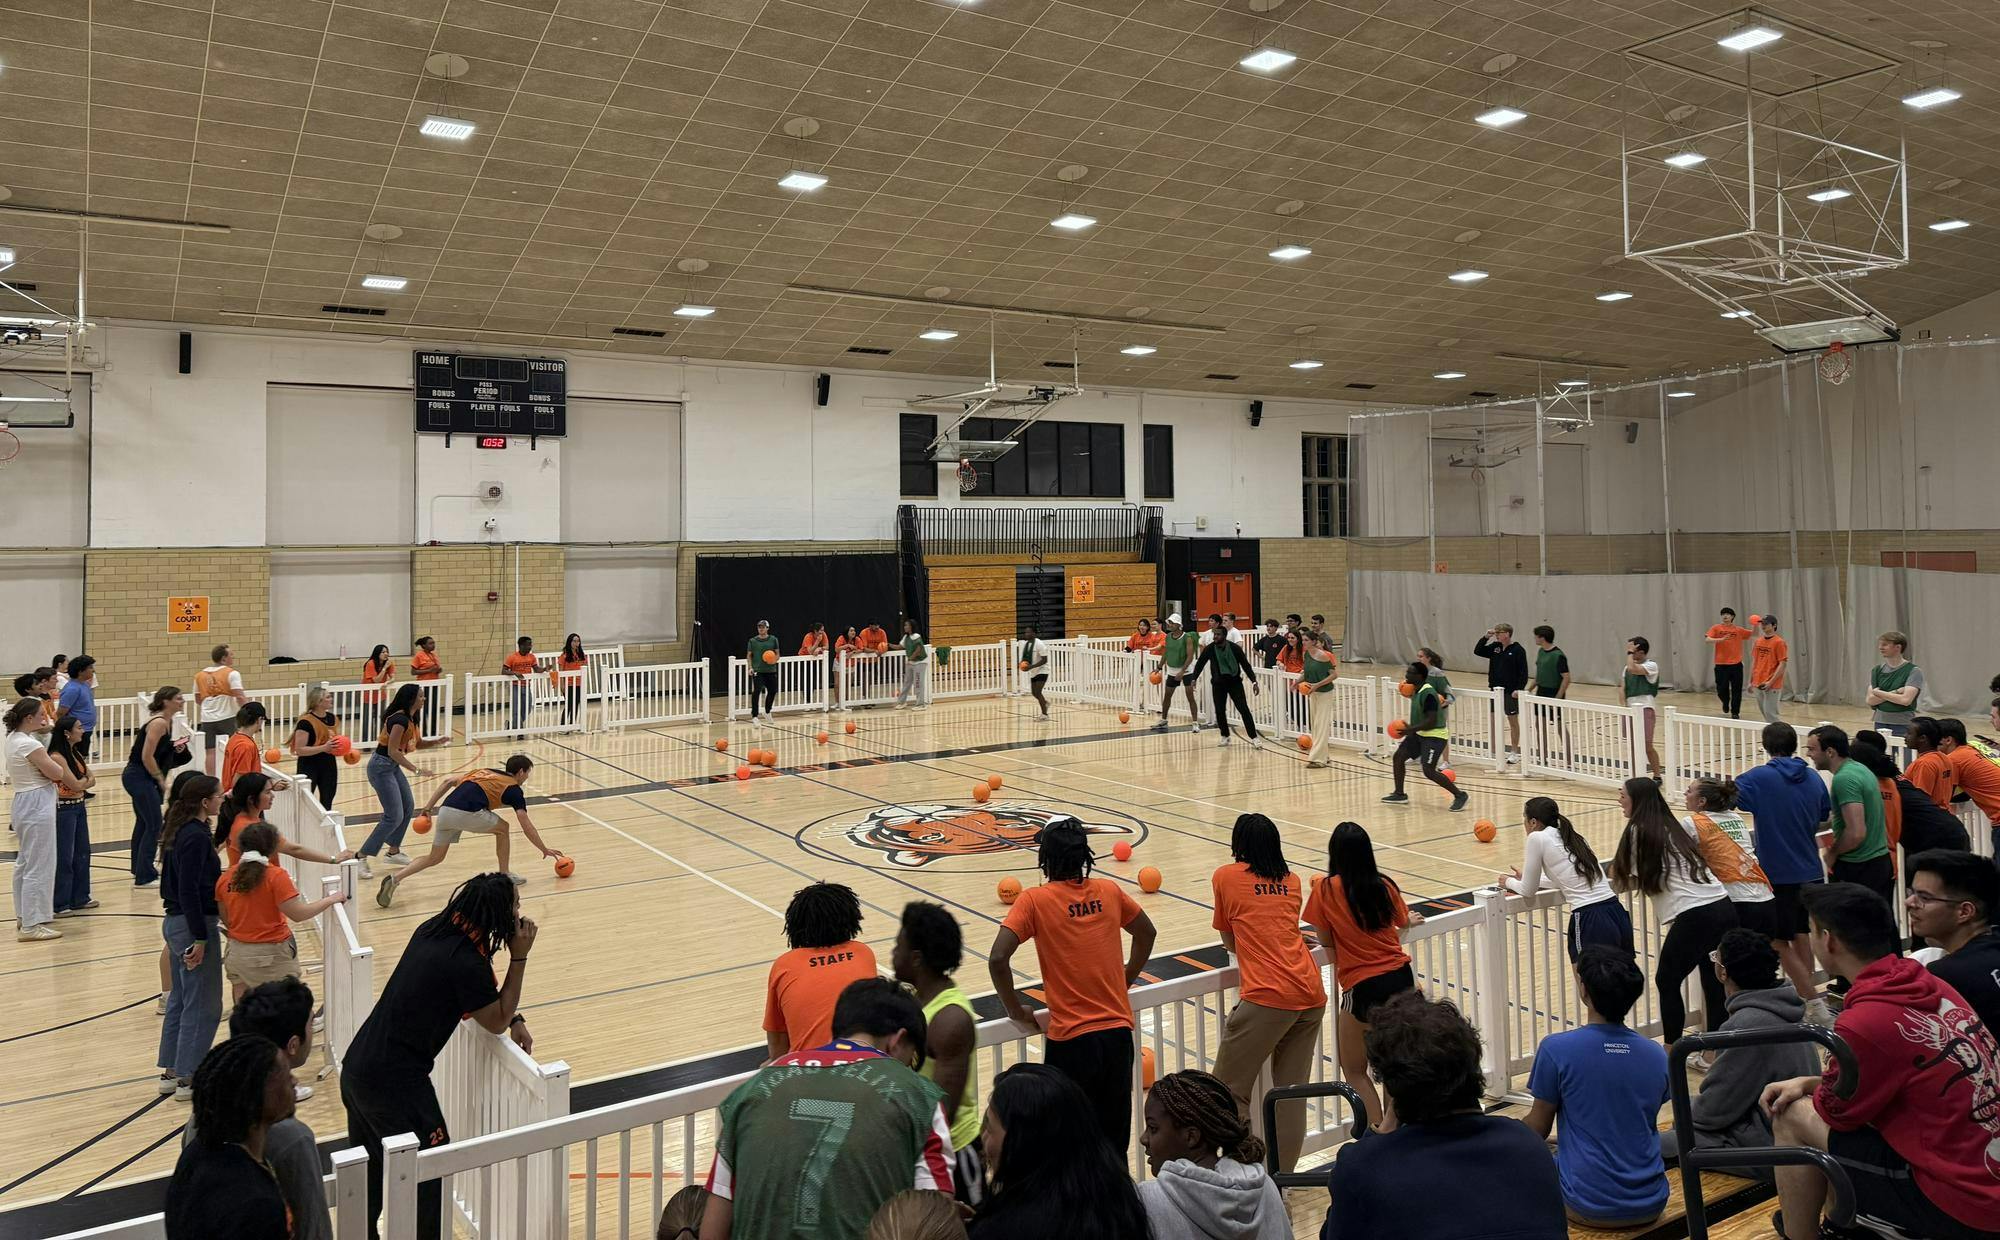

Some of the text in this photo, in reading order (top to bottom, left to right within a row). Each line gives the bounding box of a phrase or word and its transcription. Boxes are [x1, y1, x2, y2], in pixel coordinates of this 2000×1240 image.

[422, 355, 564, 372] HOME VISITOR
[432, 389, 551, 402] BONUS BONUS
[473, 387, 498, 395] PERIOD
[470, 403, 496, 411] PLAYER
[500, 404, 521, 412] FOULS
[533, 406, 555, 414] FOULS
[482, 438, 505, 447] 1052
[175, 615, 202, 623] COURT
[185, 623, 192, 631] 2
[1254, 883, 1289, 896] STAFF
[1068, 899, 1103, 918] STAFF
[808, 951, 854, 968] STAFF
[1945, 1009, 1965, 1026] NEW
[429, 1127, 444, 1146] 23
[788, 1098, 857, 1231] 7
